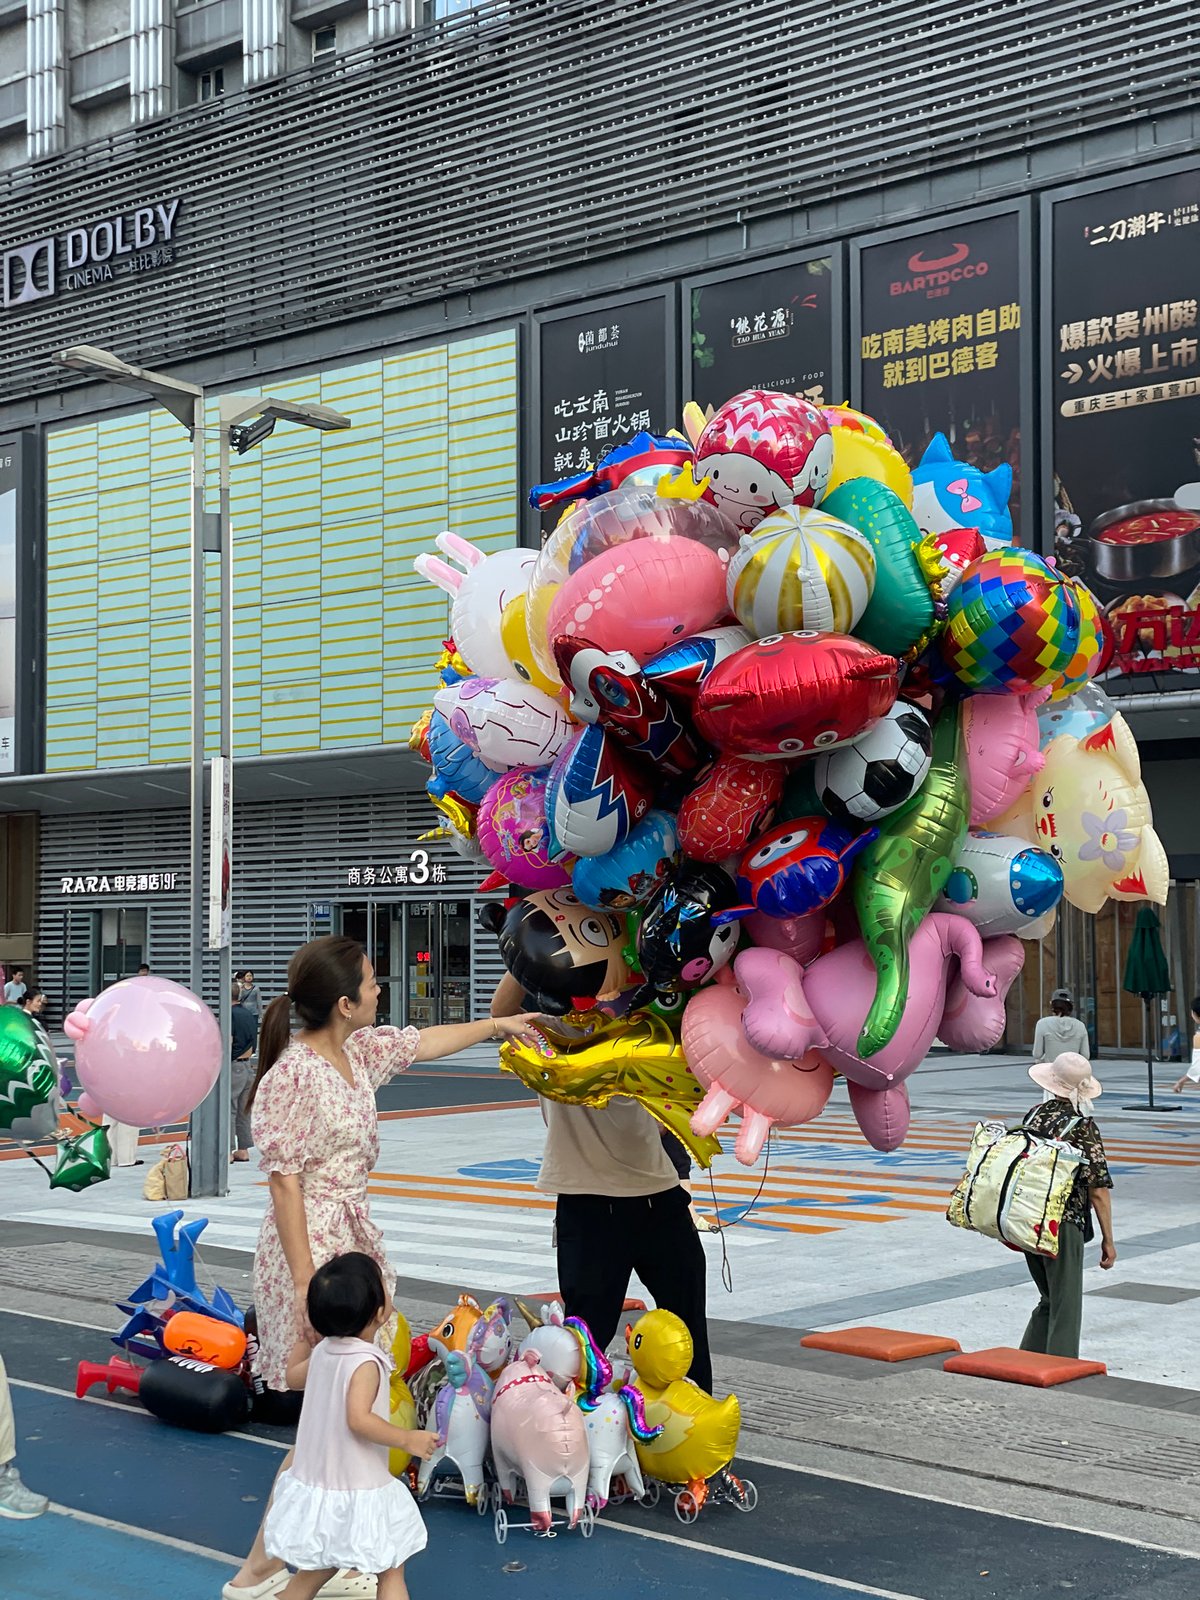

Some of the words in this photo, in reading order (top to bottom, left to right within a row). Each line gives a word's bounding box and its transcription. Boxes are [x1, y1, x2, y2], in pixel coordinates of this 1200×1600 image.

[67, 199, 180, 269] DOLBY
[1089, 211, 1166, 246] 二刀潮牛
[66, 264, 113, 291] CINEMA
[585, 324, 620, 346] 菌都荟
[736, 336, 750, 345] TAO
[752, 333, 766, 341] HUA
[768, 327, 786, 338] YUAN
[860, 302, 1021, 360] 吃南美烤肉自助
[1059, 299, 1198, 353] 爆款贵州酸
[883, 341, 999, 389] 就到巴德客
[1086, 337, 1199, 384] 火爆上市
[751, 377, 796, 391] DELICIOUS
[802, 371, 825, 381] FOOD
[1073, 380, 1197, 414] 重庆三十家直营门
[554, 390, 609, 417] 吃云南
[554, 408, 651, 443] 山珍菌火锅
[553, 446, 596, 472] 就来
[60, 875, 111, 894] RARA
[114, 872, 178, 892] 电竞酒店19F
[347, 849, 447, 886] 商务公寓3栋
